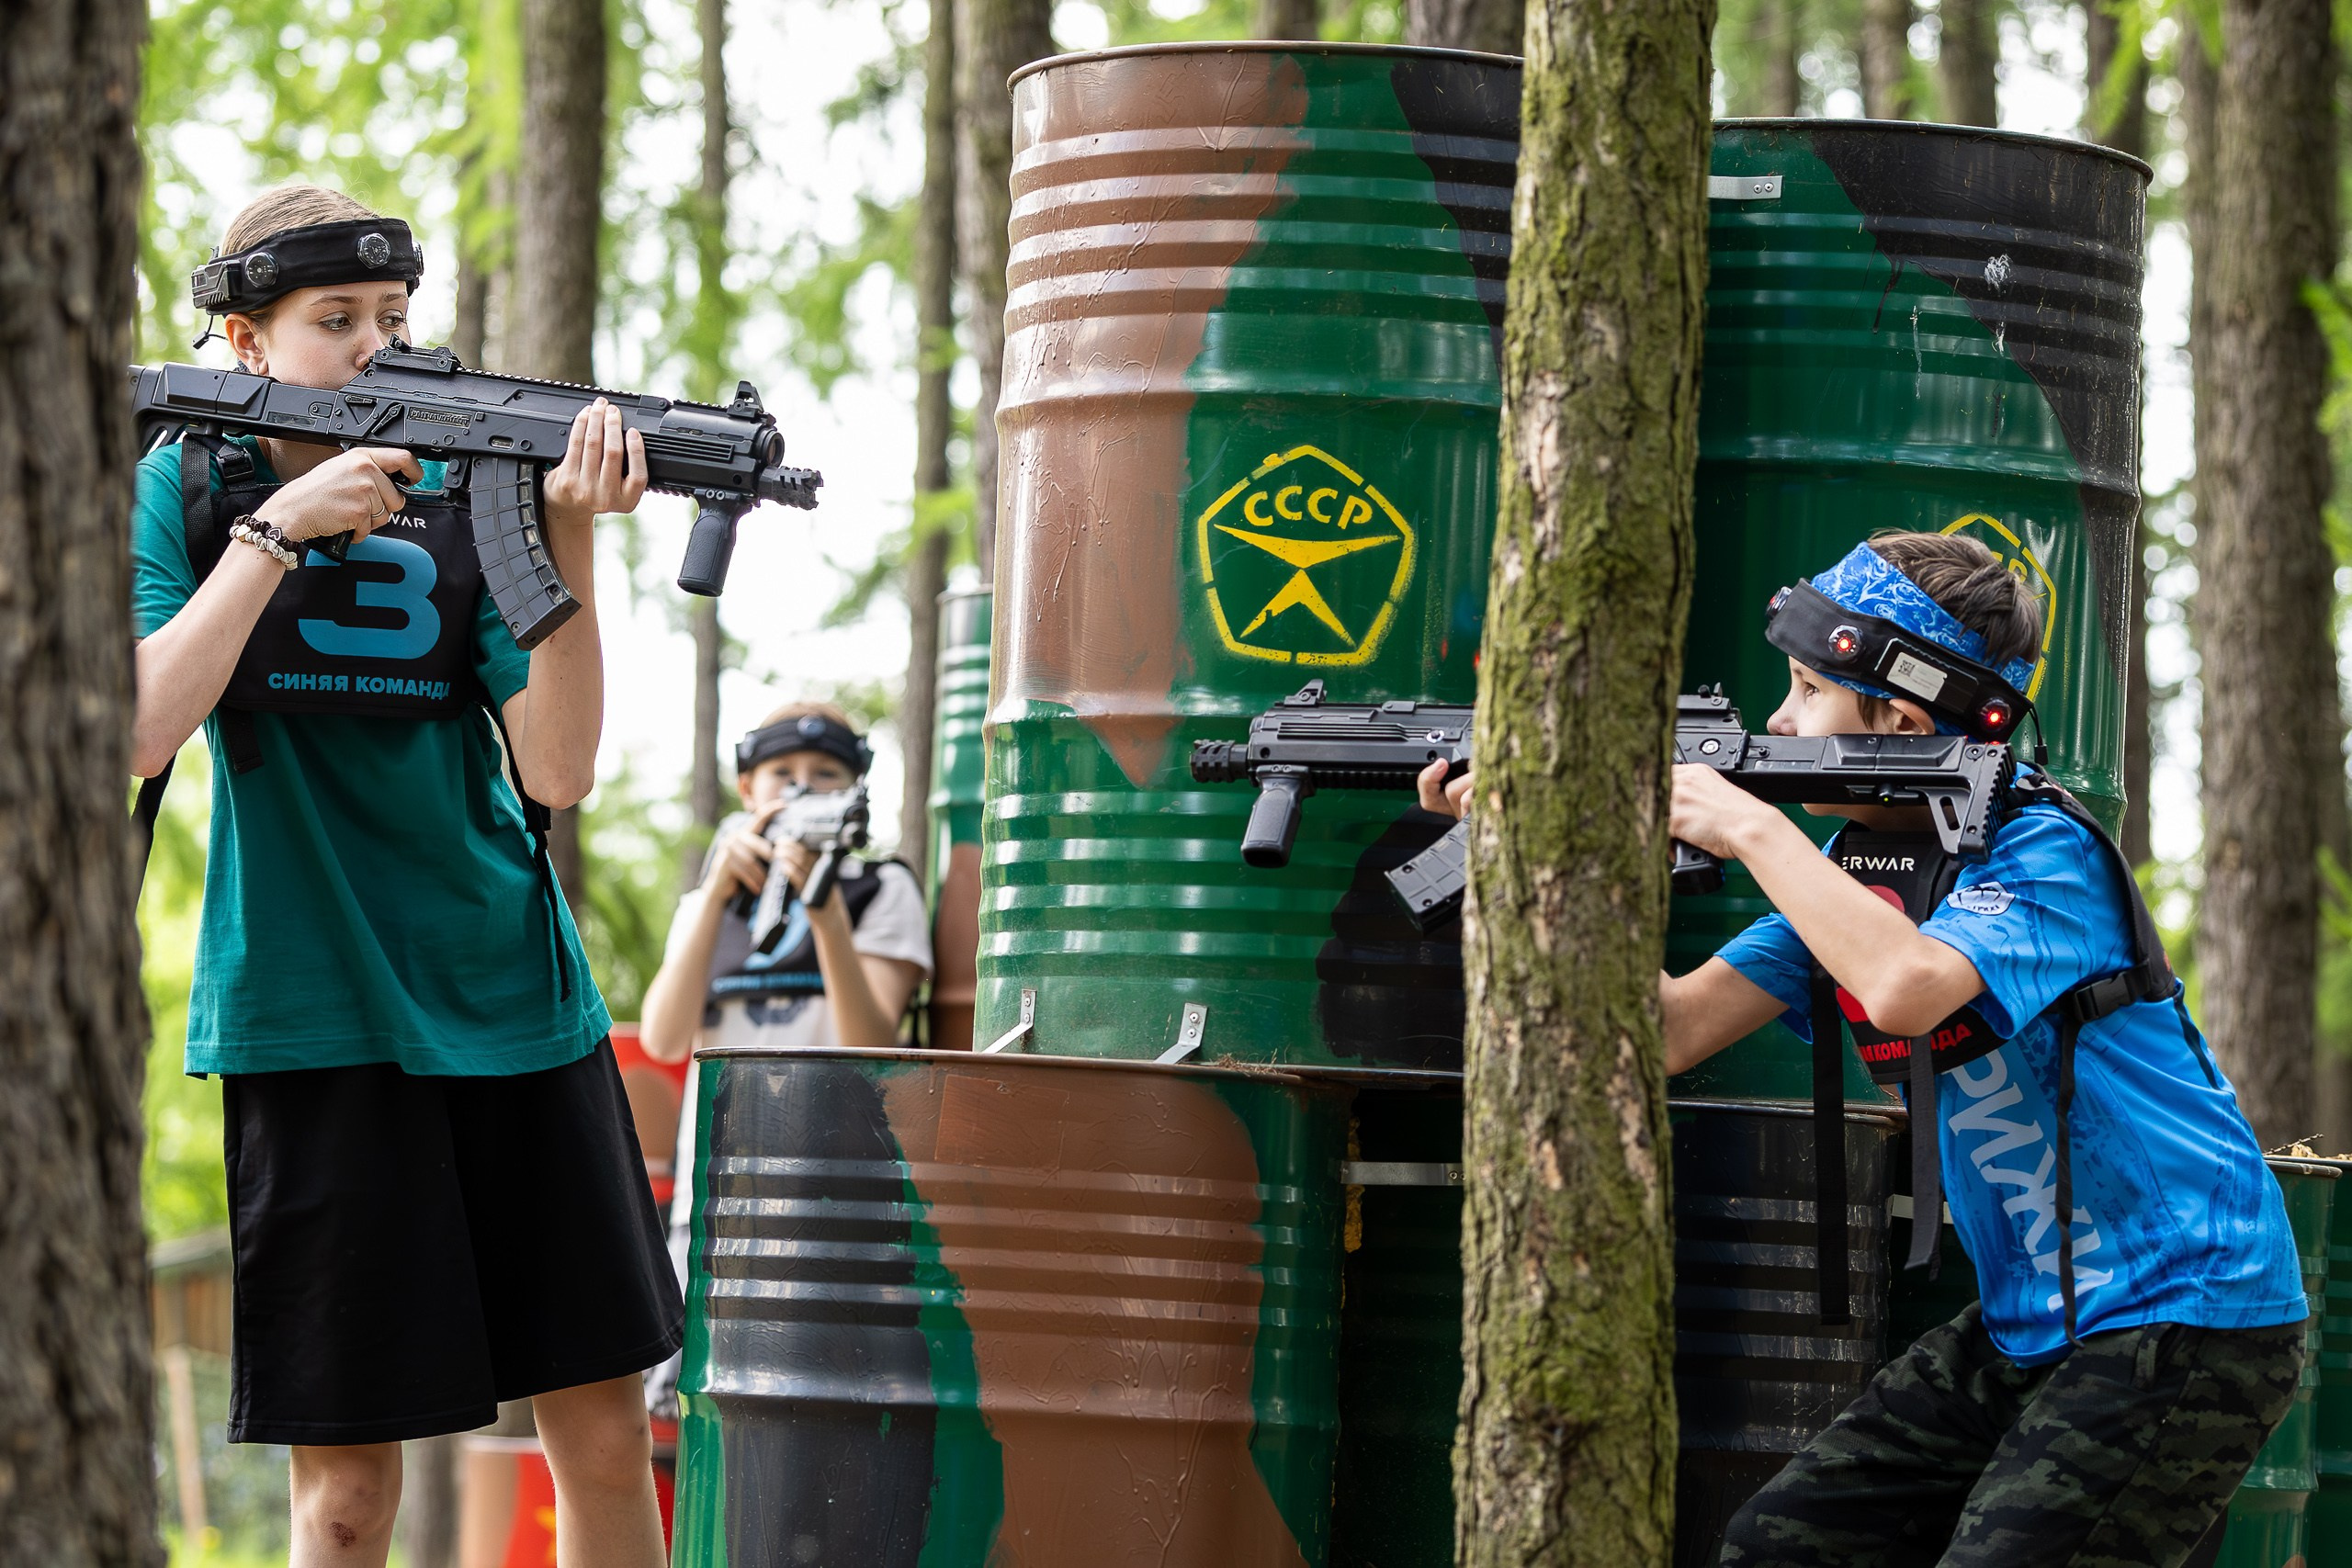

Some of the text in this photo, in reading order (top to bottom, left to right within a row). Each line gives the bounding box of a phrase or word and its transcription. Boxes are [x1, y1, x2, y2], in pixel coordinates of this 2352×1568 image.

[1243, 485, 1373, 530] СССР
[298, 534, 441, 660] 3
[267, 672, 349, 693] СИНЯЯ
